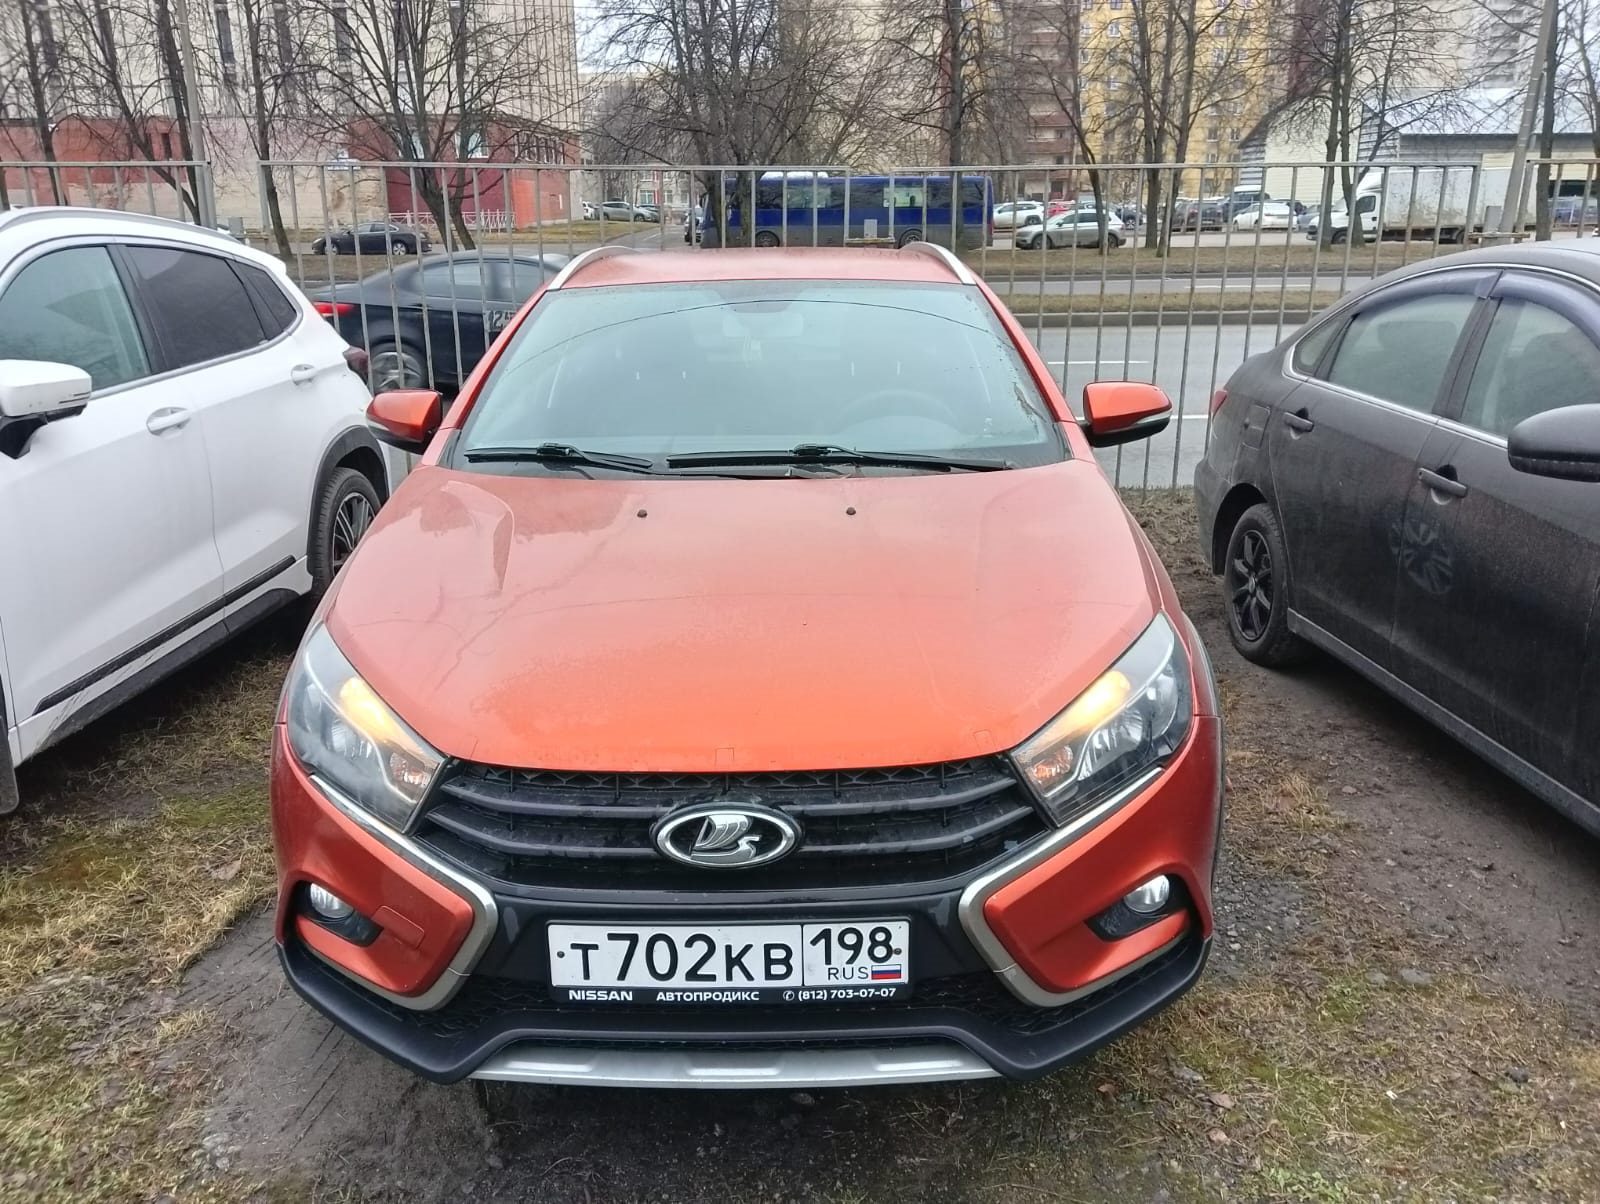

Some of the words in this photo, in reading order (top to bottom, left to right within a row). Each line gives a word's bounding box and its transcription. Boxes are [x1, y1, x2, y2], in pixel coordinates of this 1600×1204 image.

[570, 932, 793, 982] Т702КВ
[809, 926, 893, 965] 198
[827, 966, 869, 980] RUS
[568, 989, 633, 1001] NISSAN
[656, 991, 760, 1003] АВТОПРОДИКС
[798, 989, 828, 1001] (812)
[830, 987, 897, 999] 703-07-07
